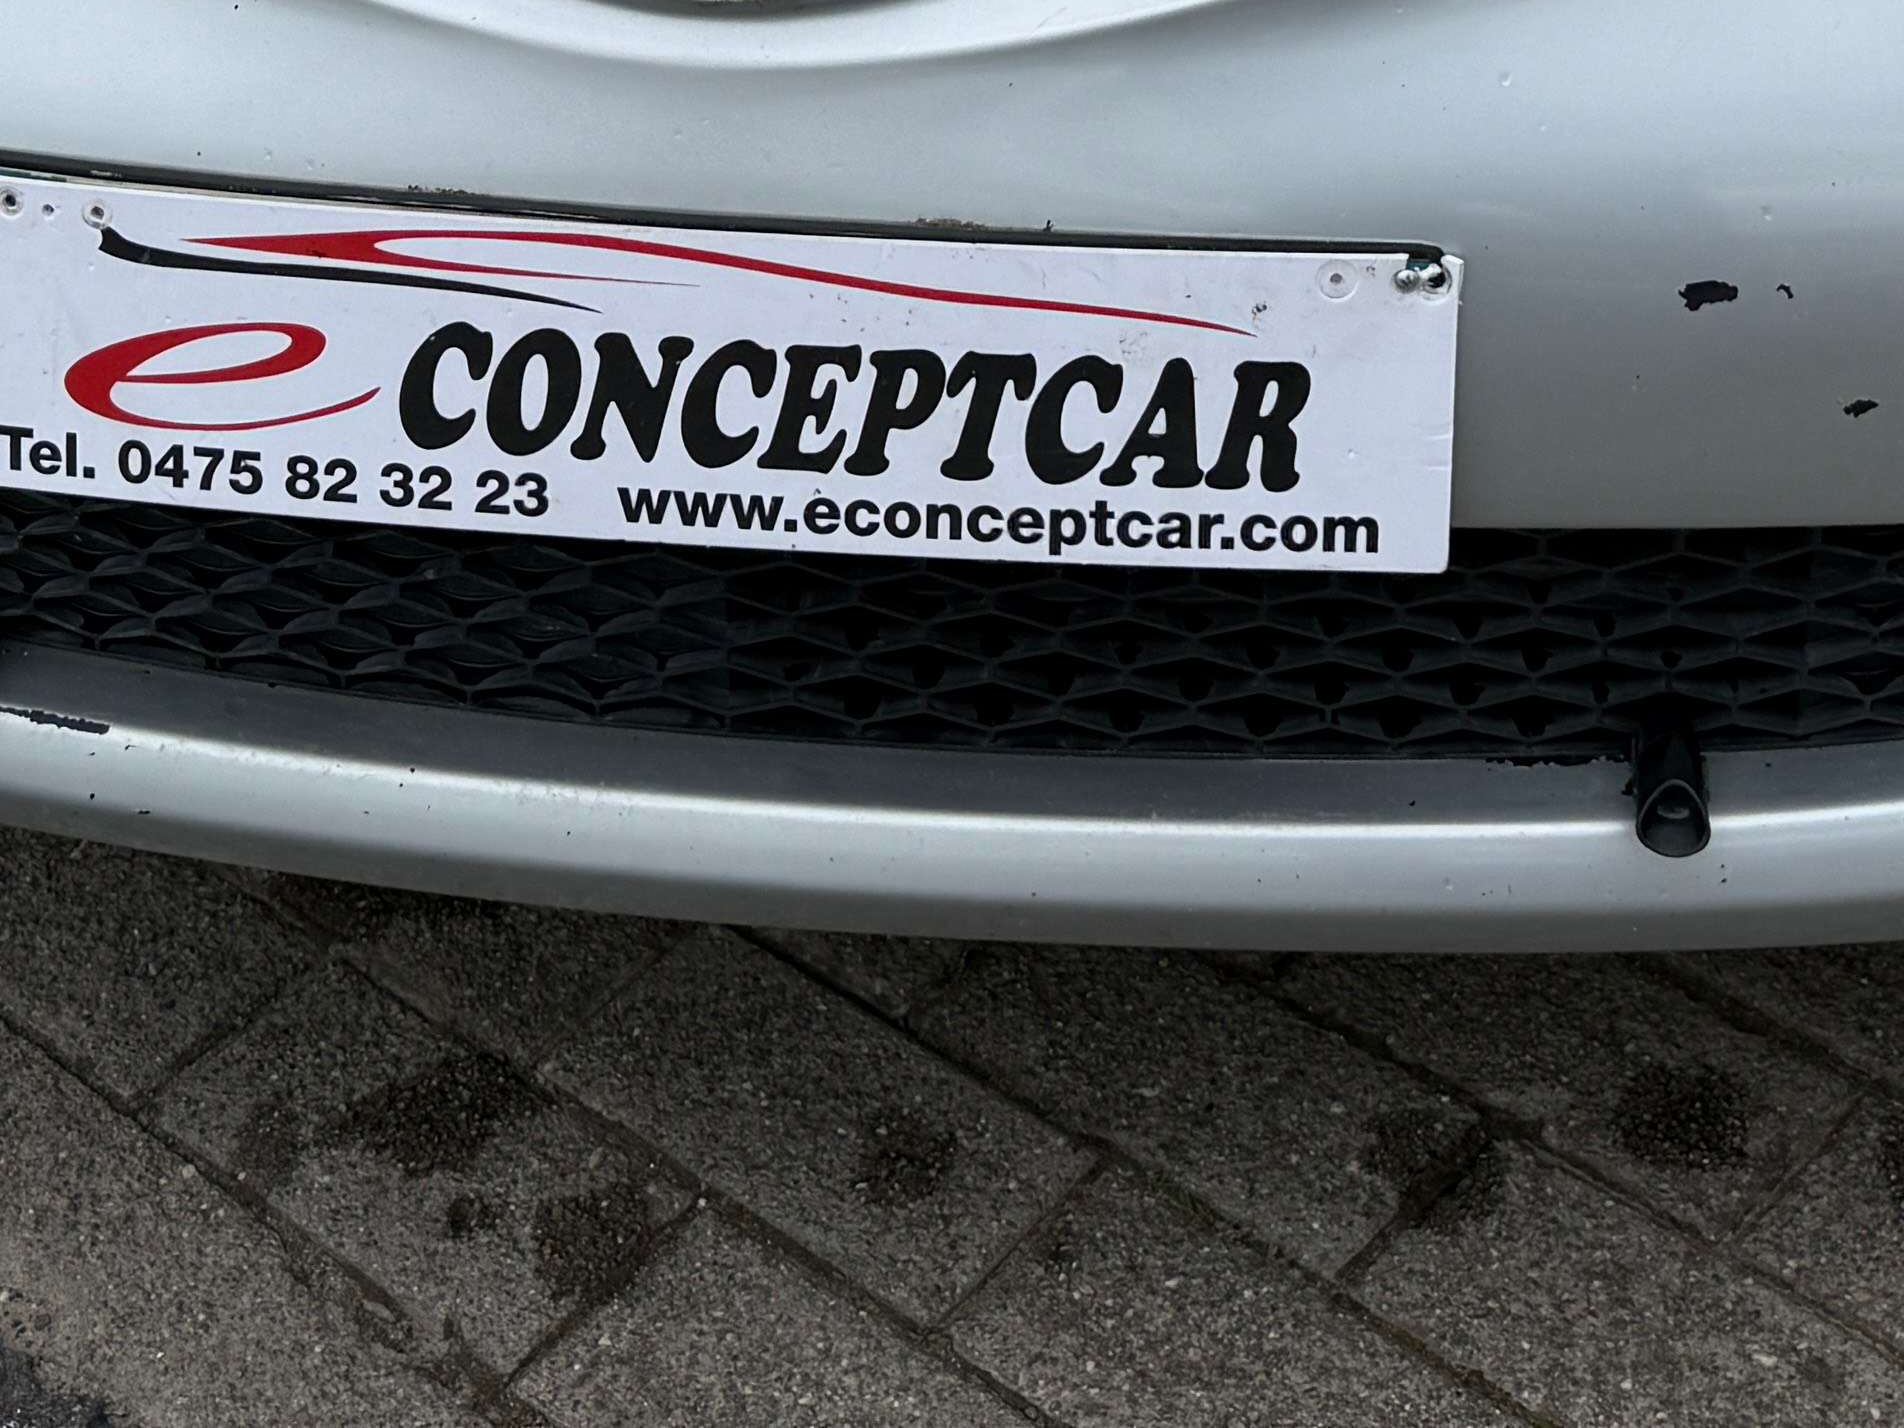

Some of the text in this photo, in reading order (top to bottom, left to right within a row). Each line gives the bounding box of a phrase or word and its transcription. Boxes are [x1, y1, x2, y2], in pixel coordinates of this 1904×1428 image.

[64, 320, 1312, 492] e CONCEPTCAR
[118, 439, 264, 495] 0475
[285, 454, 359, 504] 82
[378, 463, 453, 511] 32
[474, 469, 551, 518] 23
[616, 485, 1380, 555] www.econceptcar.com
